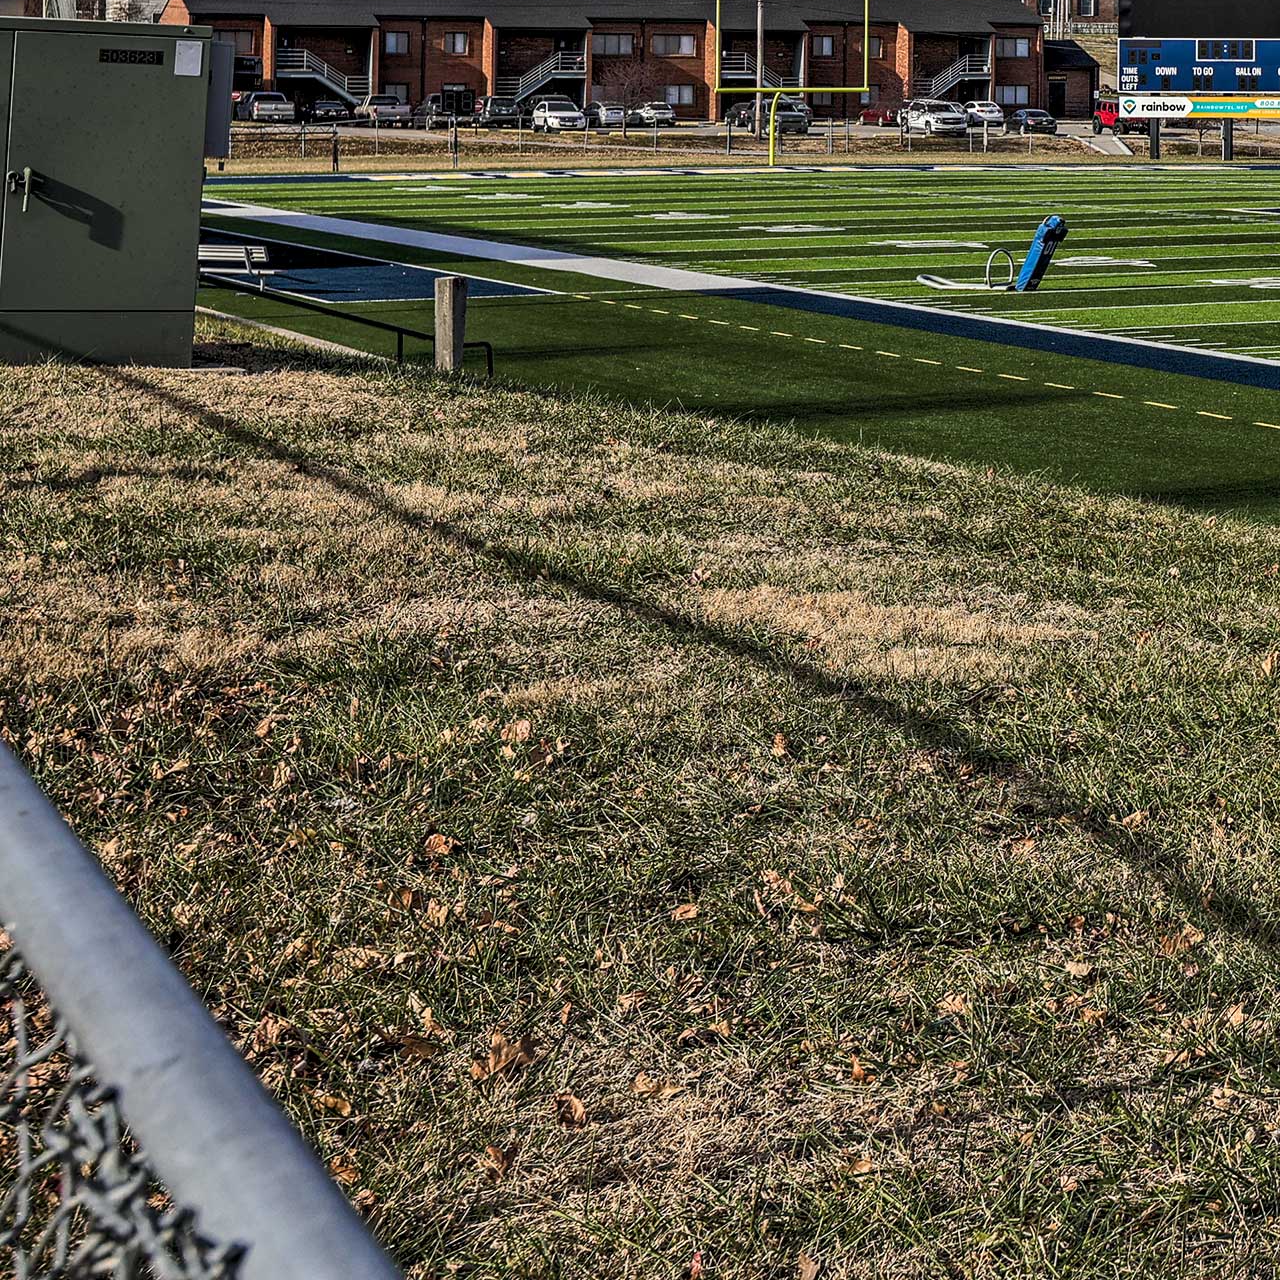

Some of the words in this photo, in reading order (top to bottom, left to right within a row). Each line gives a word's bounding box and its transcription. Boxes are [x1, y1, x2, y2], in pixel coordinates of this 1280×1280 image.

[1155, 67, 1177, 75] DOWN
[1192, 67, 1202, 76] TO
[1203, 67, 1214, 76] GO
[1235, 67, 1251, 76] BALL
[1252, 67, 1262, 76] ON
[1121, 75, 1139, 83] OUTS
[1141, 102, 1186, 112] rainbow
